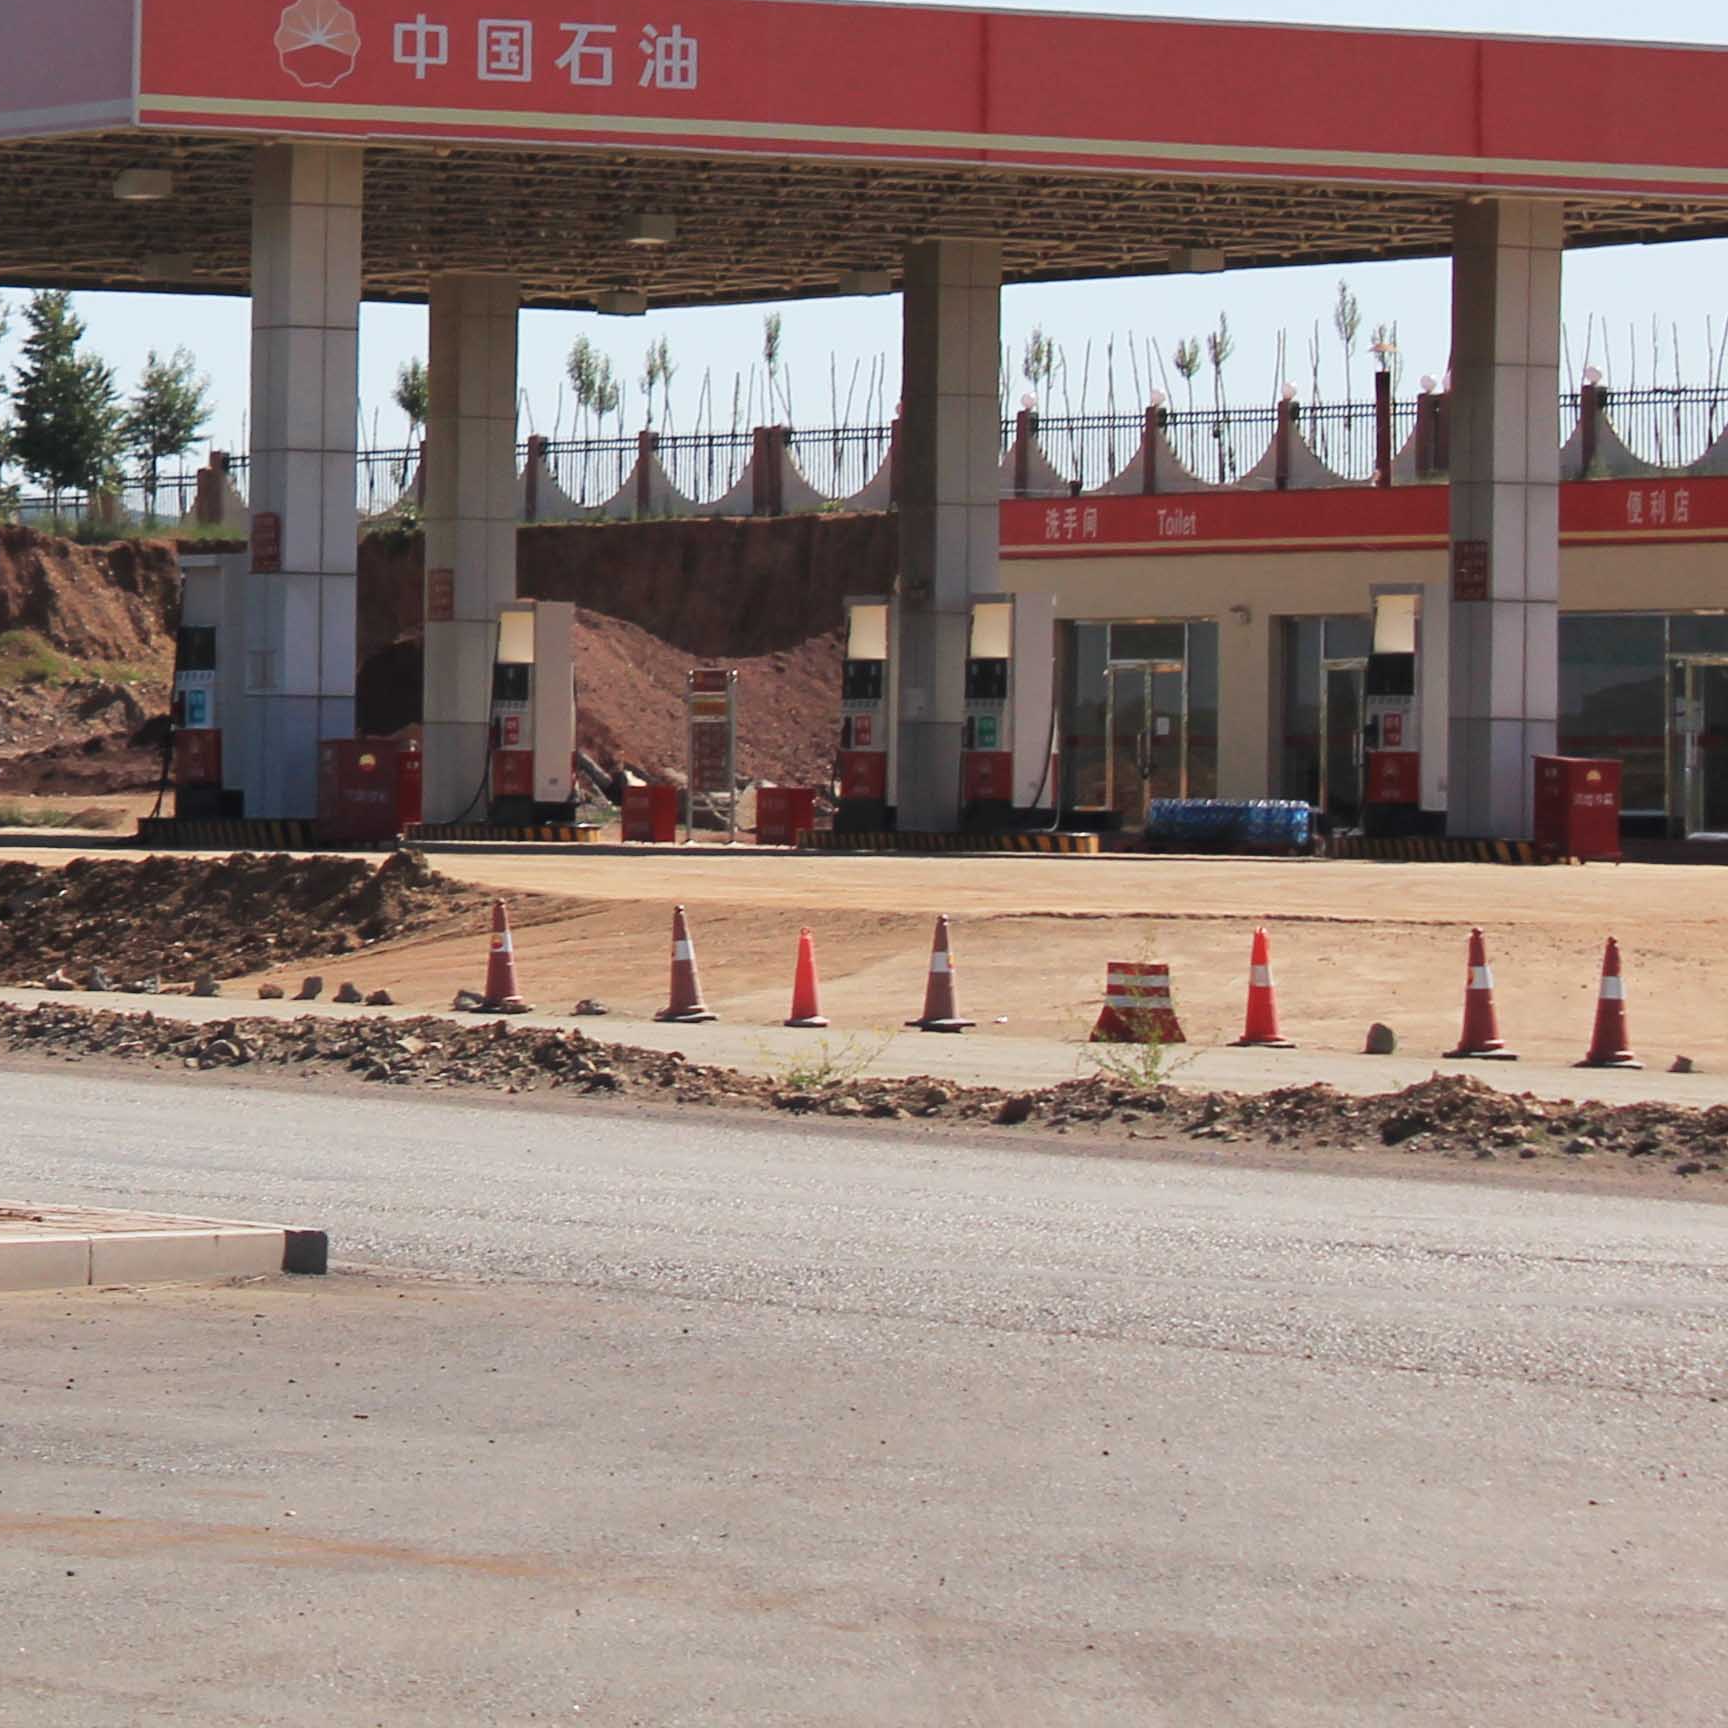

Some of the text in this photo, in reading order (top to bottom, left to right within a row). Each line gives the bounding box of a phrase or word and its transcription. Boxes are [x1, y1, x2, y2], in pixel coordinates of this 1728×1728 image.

[392, 13, 699, 91] 中国石油
[1045, 507, 1098, 540] 洗手间
[1156, 508, 1197, 536] Toilet
[1626, 488, 1689, 525] 便利店
